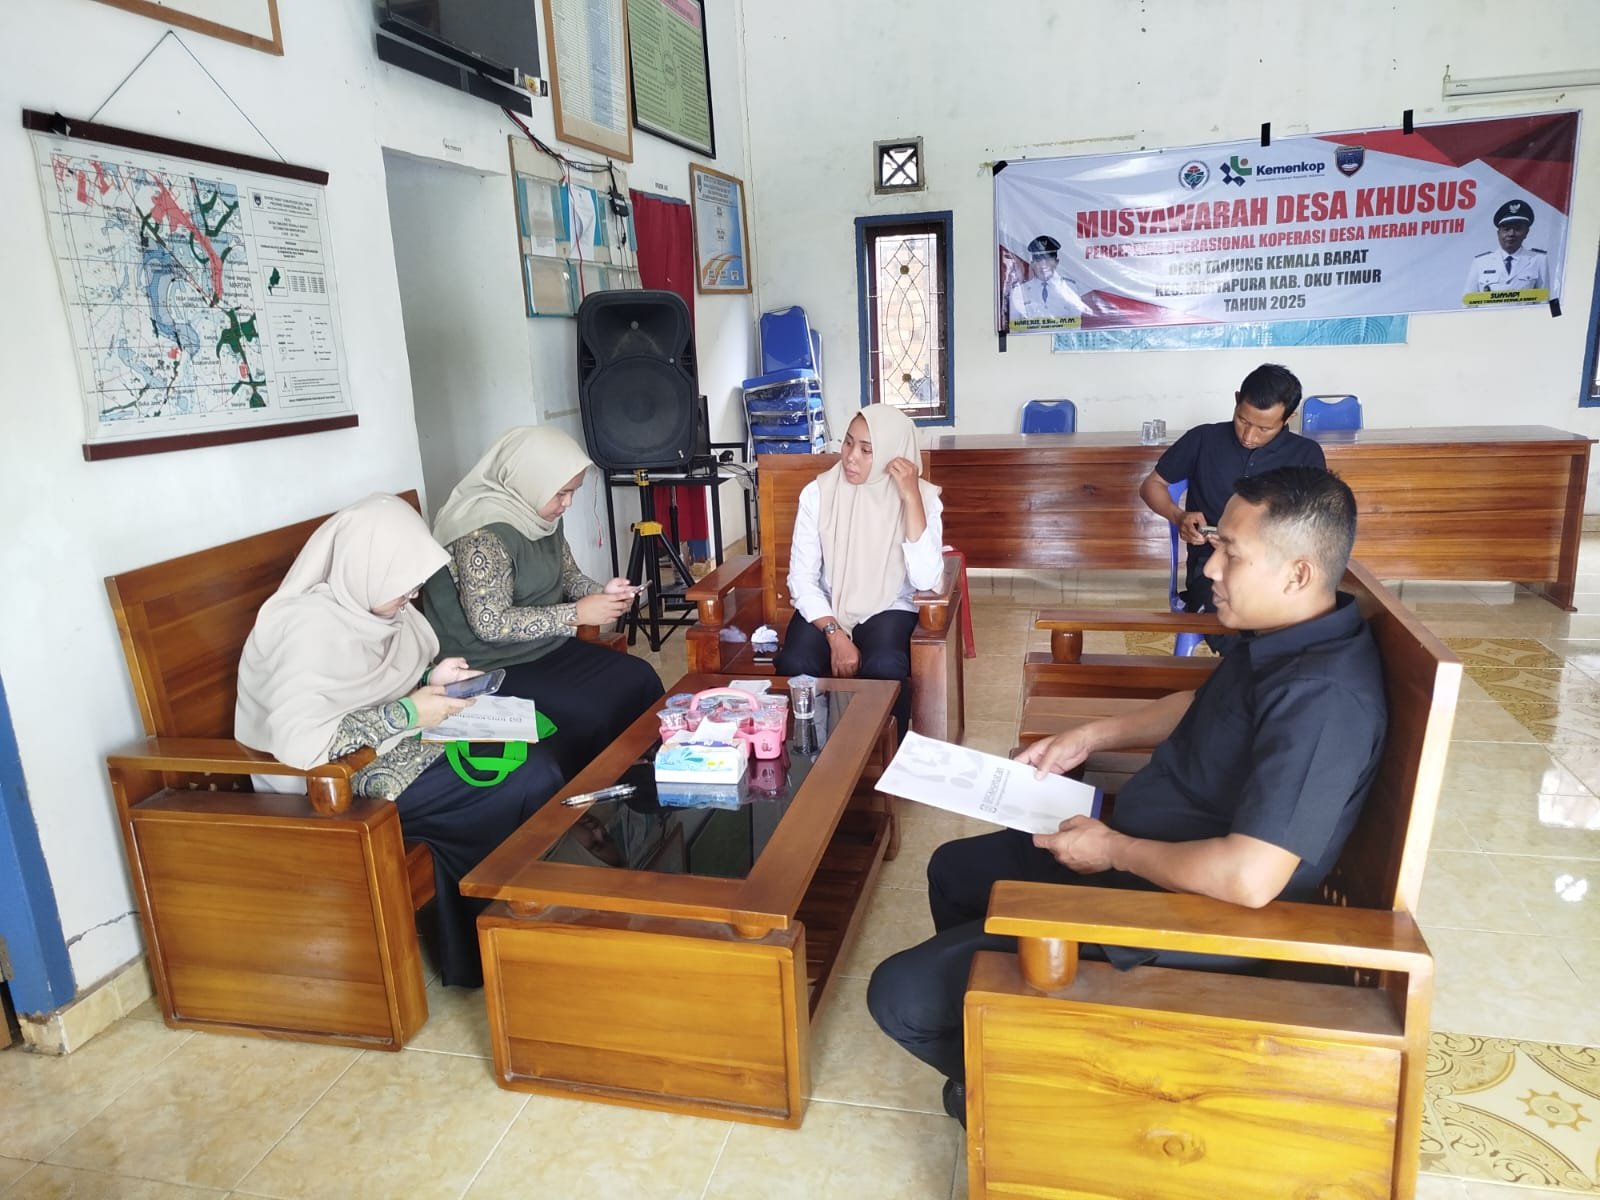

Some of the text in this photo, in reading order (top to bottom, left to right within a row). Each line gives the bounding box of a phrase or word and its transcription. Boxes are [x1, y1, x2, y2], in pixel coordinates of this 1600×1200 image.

[1256, 161, 1325, 177] Kemenkop
[1076, 179, 1477, 239] MUSYAWARAH DESA KHUSUS
[1259, 229, 1325, 248] KOPERASI
[1329, 225, 1365, 242] DESA
[1368, 221, 1417, 240] MERAH
[1421, 218, 1465, 235] PUTIH
[1206, 256, 1263, 274] TANJUNG
[1266, 252, 1321, 270] KEMALA
[1323, 249, 1369, 266] BARAT
[1269, 275, 1300, 290] KAB.
[1304, 272, 1332, 287] OKU
[1335, 269, 1382, 285] TIMUR
[1224, 294, 1306, 312] TAHUN 2025
